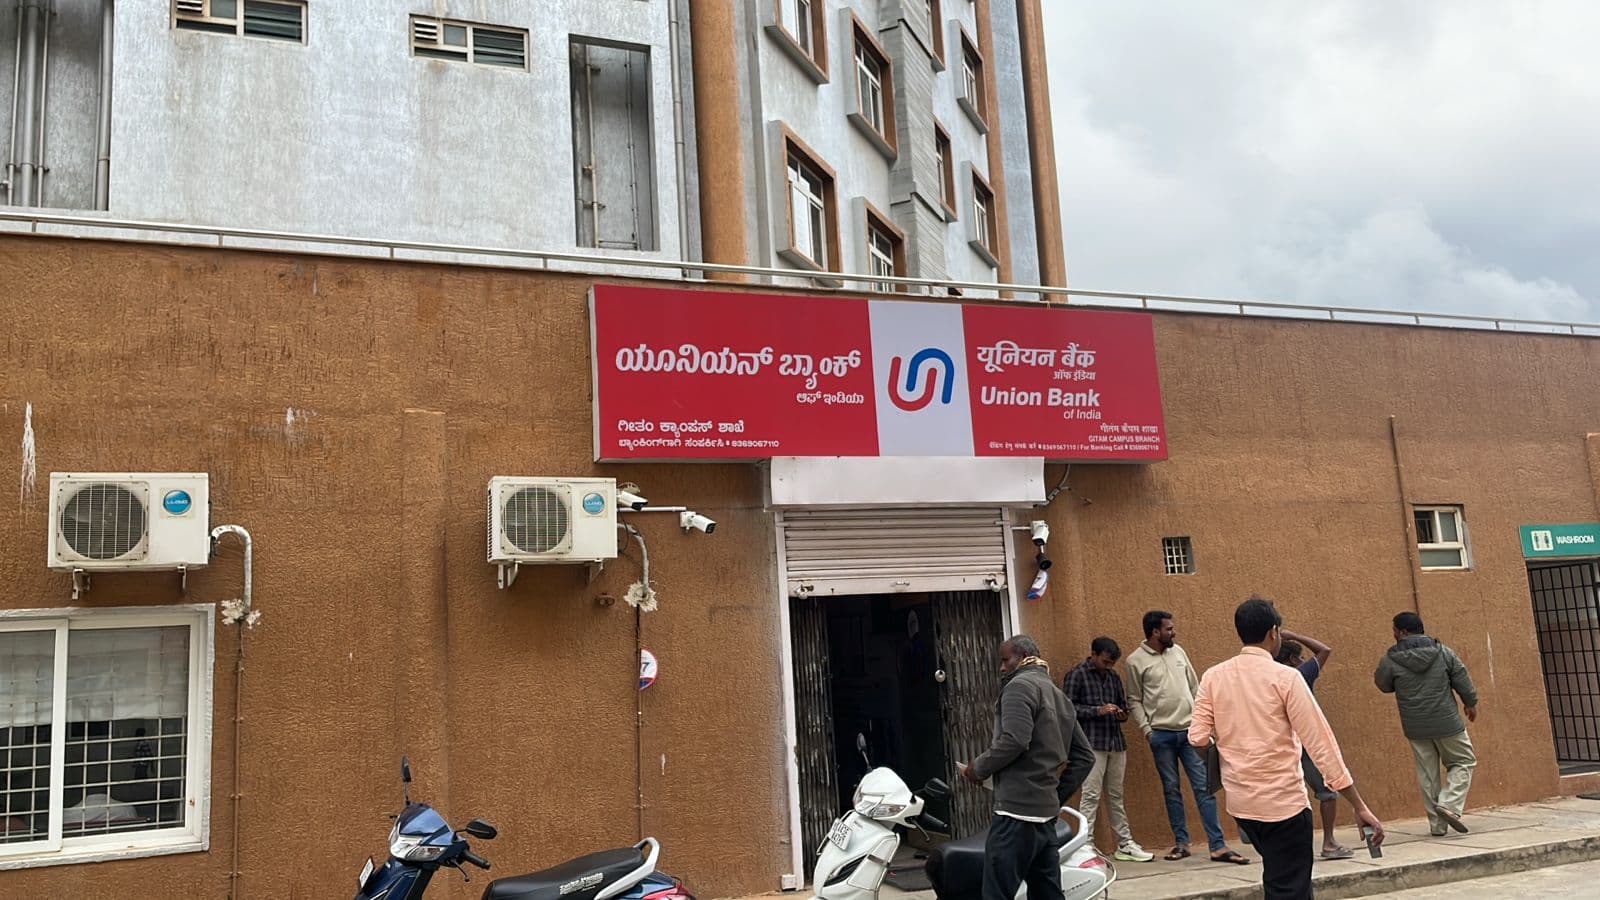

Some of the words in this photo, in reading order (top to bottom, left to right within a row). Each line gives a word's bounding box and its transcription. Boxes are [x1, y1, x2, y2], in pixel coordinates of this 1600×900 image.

[976, 340, 1057, 373] यूनियन
[1060, 342, 1097, 368] बैंक
[615, 343, 774, 376] ಯೂನಿಯನ್
[778, 349, 862, 390] ಬ್ಯಾಂಕ್
[1073, 369, 1096, 381] इंडिया
[823, 391, 864, 405] ಇಂಡಿಯಾ
[981, 386, 1042, 406] Union
[1047, 388, 1100, 407] Bank
[1063, 409, 1074, 419] of
[1076, 409, 1101, 419] India
[618, 419, 654, 432] ಗೀತಂ
[1556, 535, 1595, 545] WASHROOM
